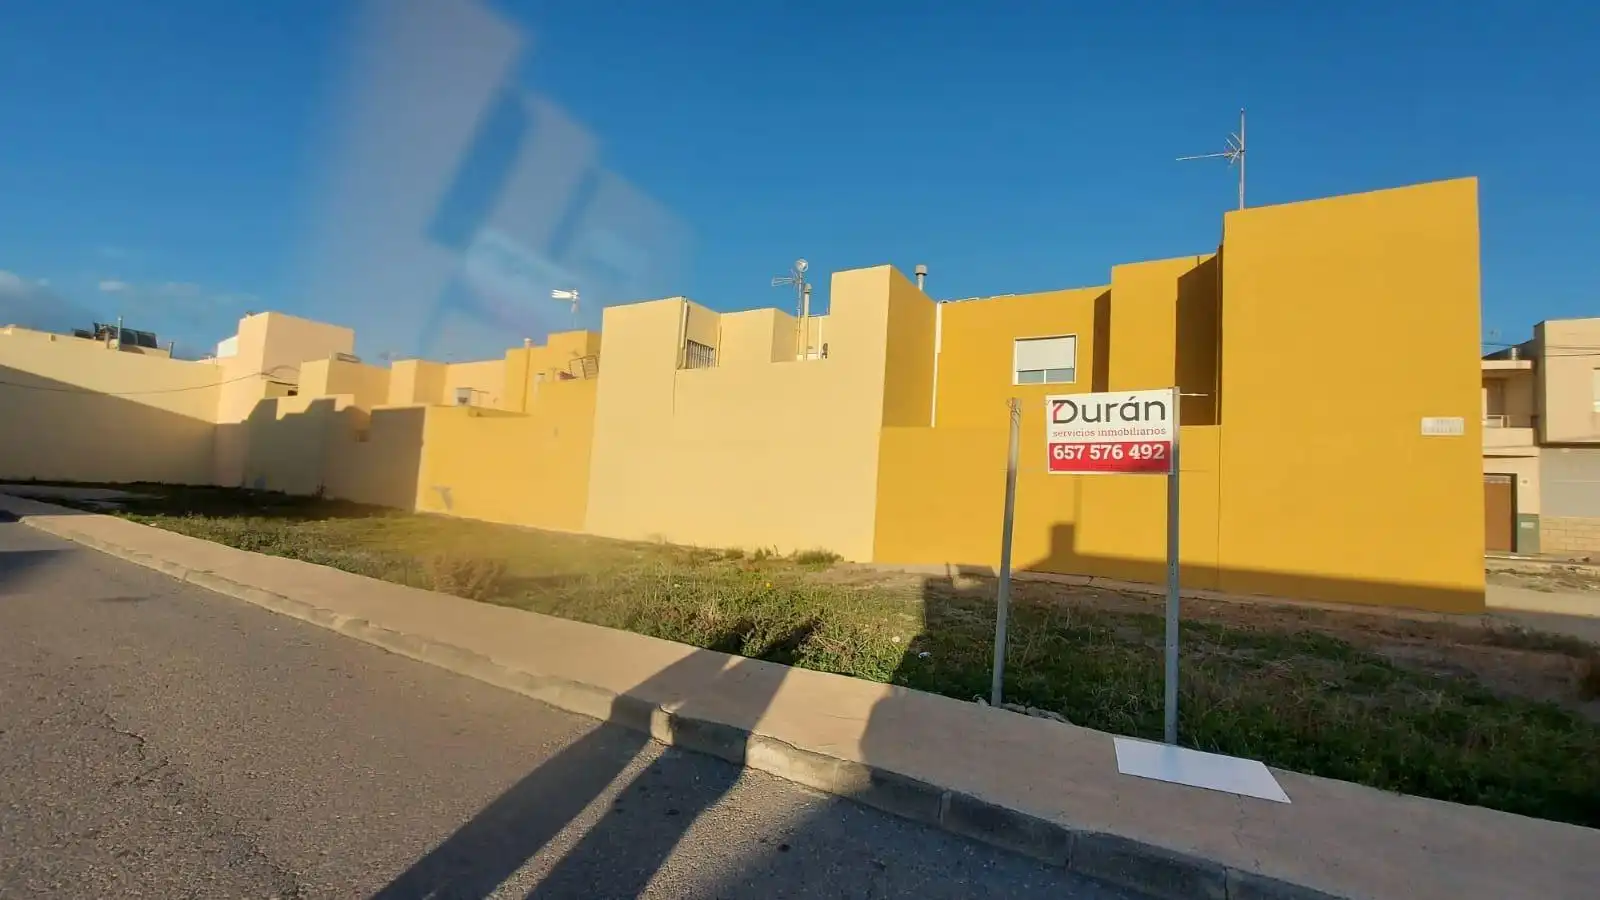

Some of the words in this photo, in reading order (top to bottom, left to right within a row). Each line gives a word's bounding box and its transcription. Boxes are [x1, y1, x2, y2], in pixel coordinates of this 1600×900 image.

[1052, 396, 1166, 424] Durán
[1053, 427, 1096, 438] servicios
[1097, 426, 1167, 437] inmobiliarios
[1053, 444, 1085, 460] 657
[1089, 444, 1124, 460] 576
[1128, 444, 1165, 460] 492
